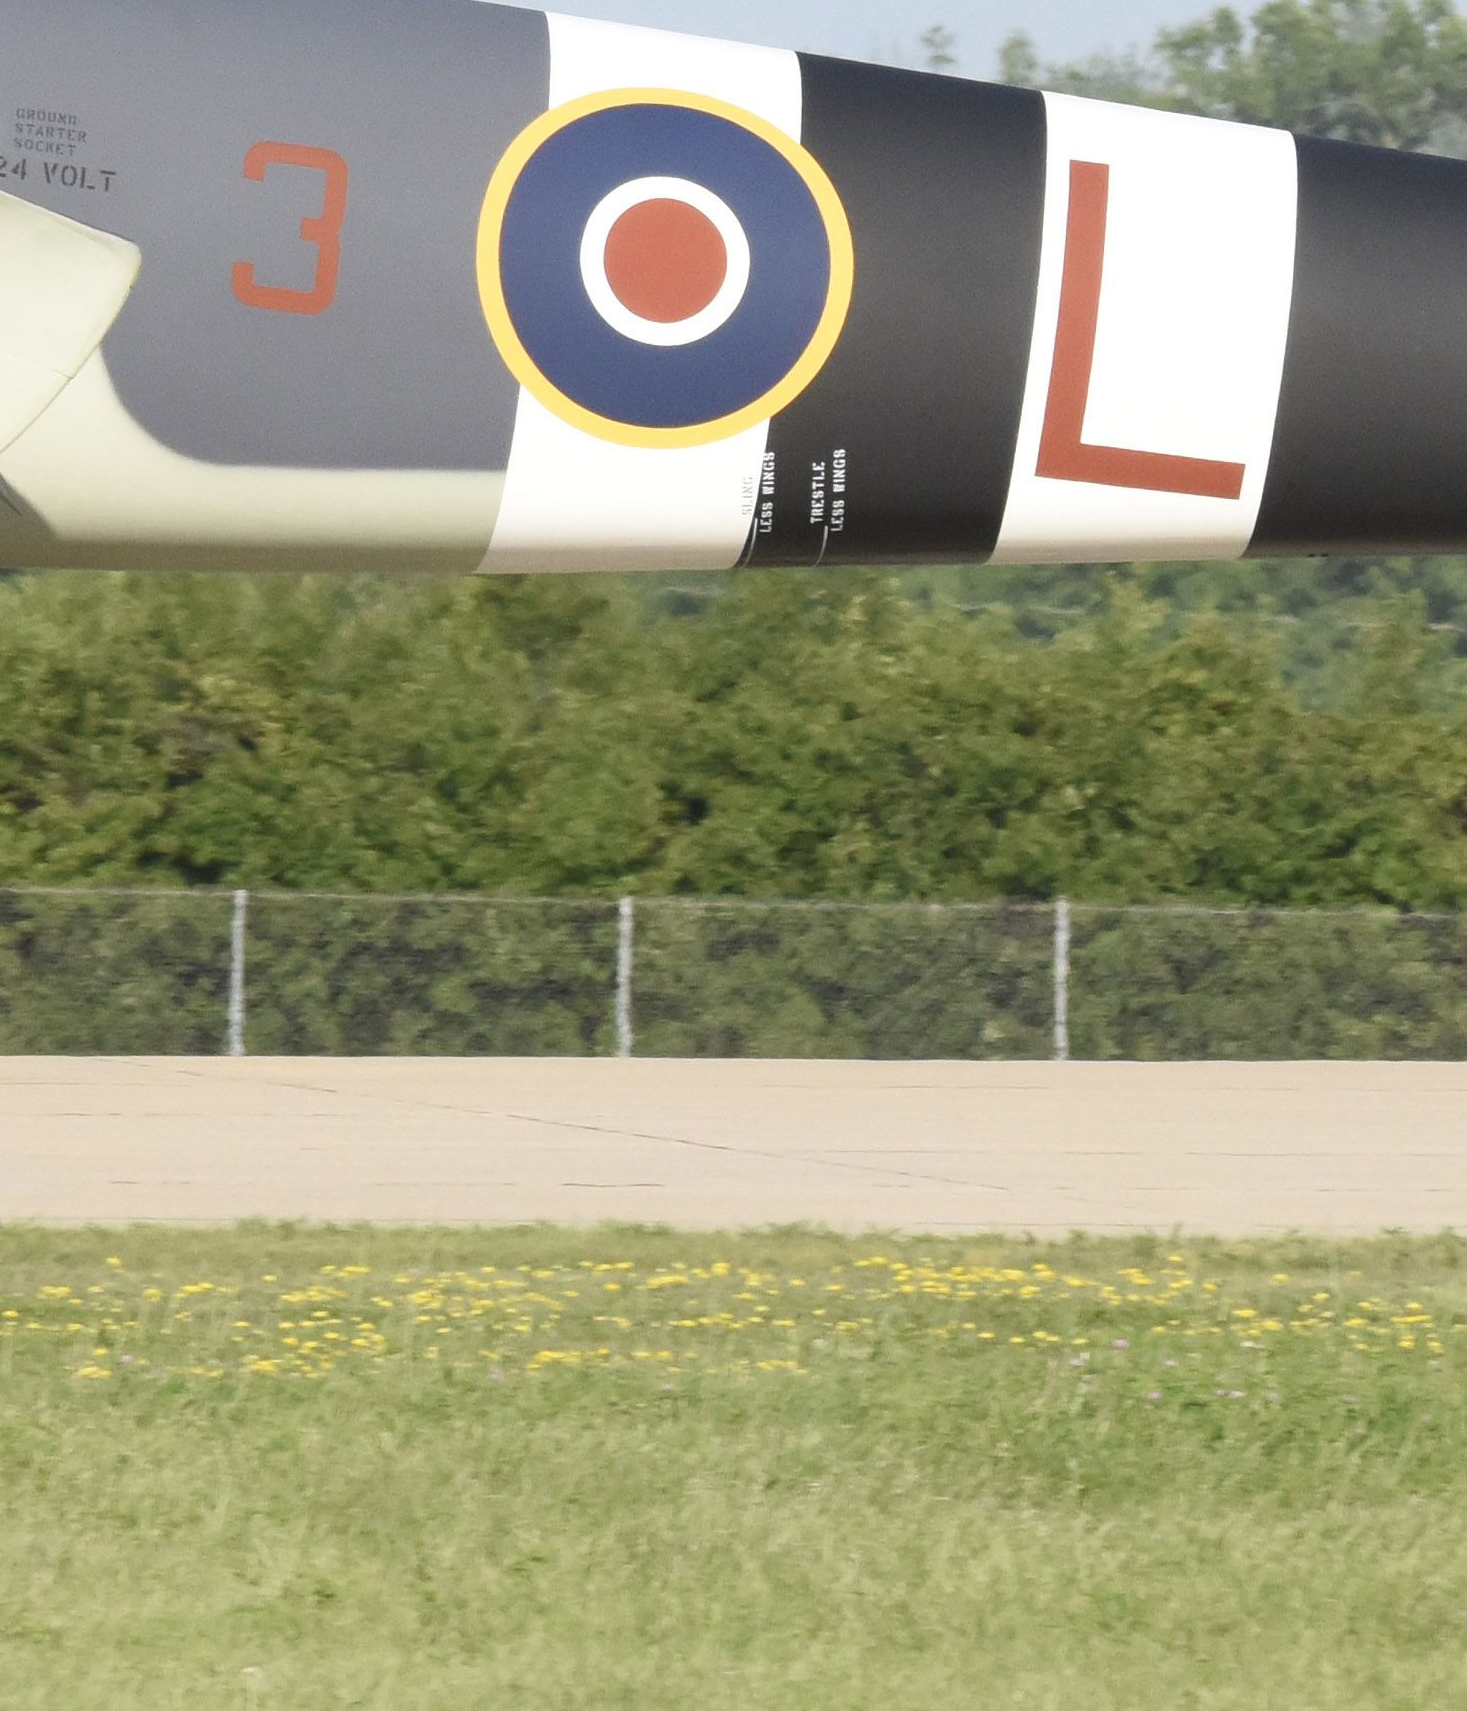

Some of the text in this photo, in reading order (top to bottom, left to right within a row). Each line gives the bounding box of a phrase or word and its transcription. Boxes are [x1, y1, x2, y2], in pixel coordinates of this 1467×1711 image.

[13, 138, 76, 156] SOCKET
[15, 123, 87, 142] STARTER
[16, 108, 77, 126] GROUND
[43, 161, 116, 192] VOLT
[231, 141, 348, 316] 3
[1035, 159, 1246, 501] L
[759, 451, 775, 533] LESS WINGS
[810, 461, 826, 524] TRESTLE
[830, 449, 846, 532] LESS WINGS
